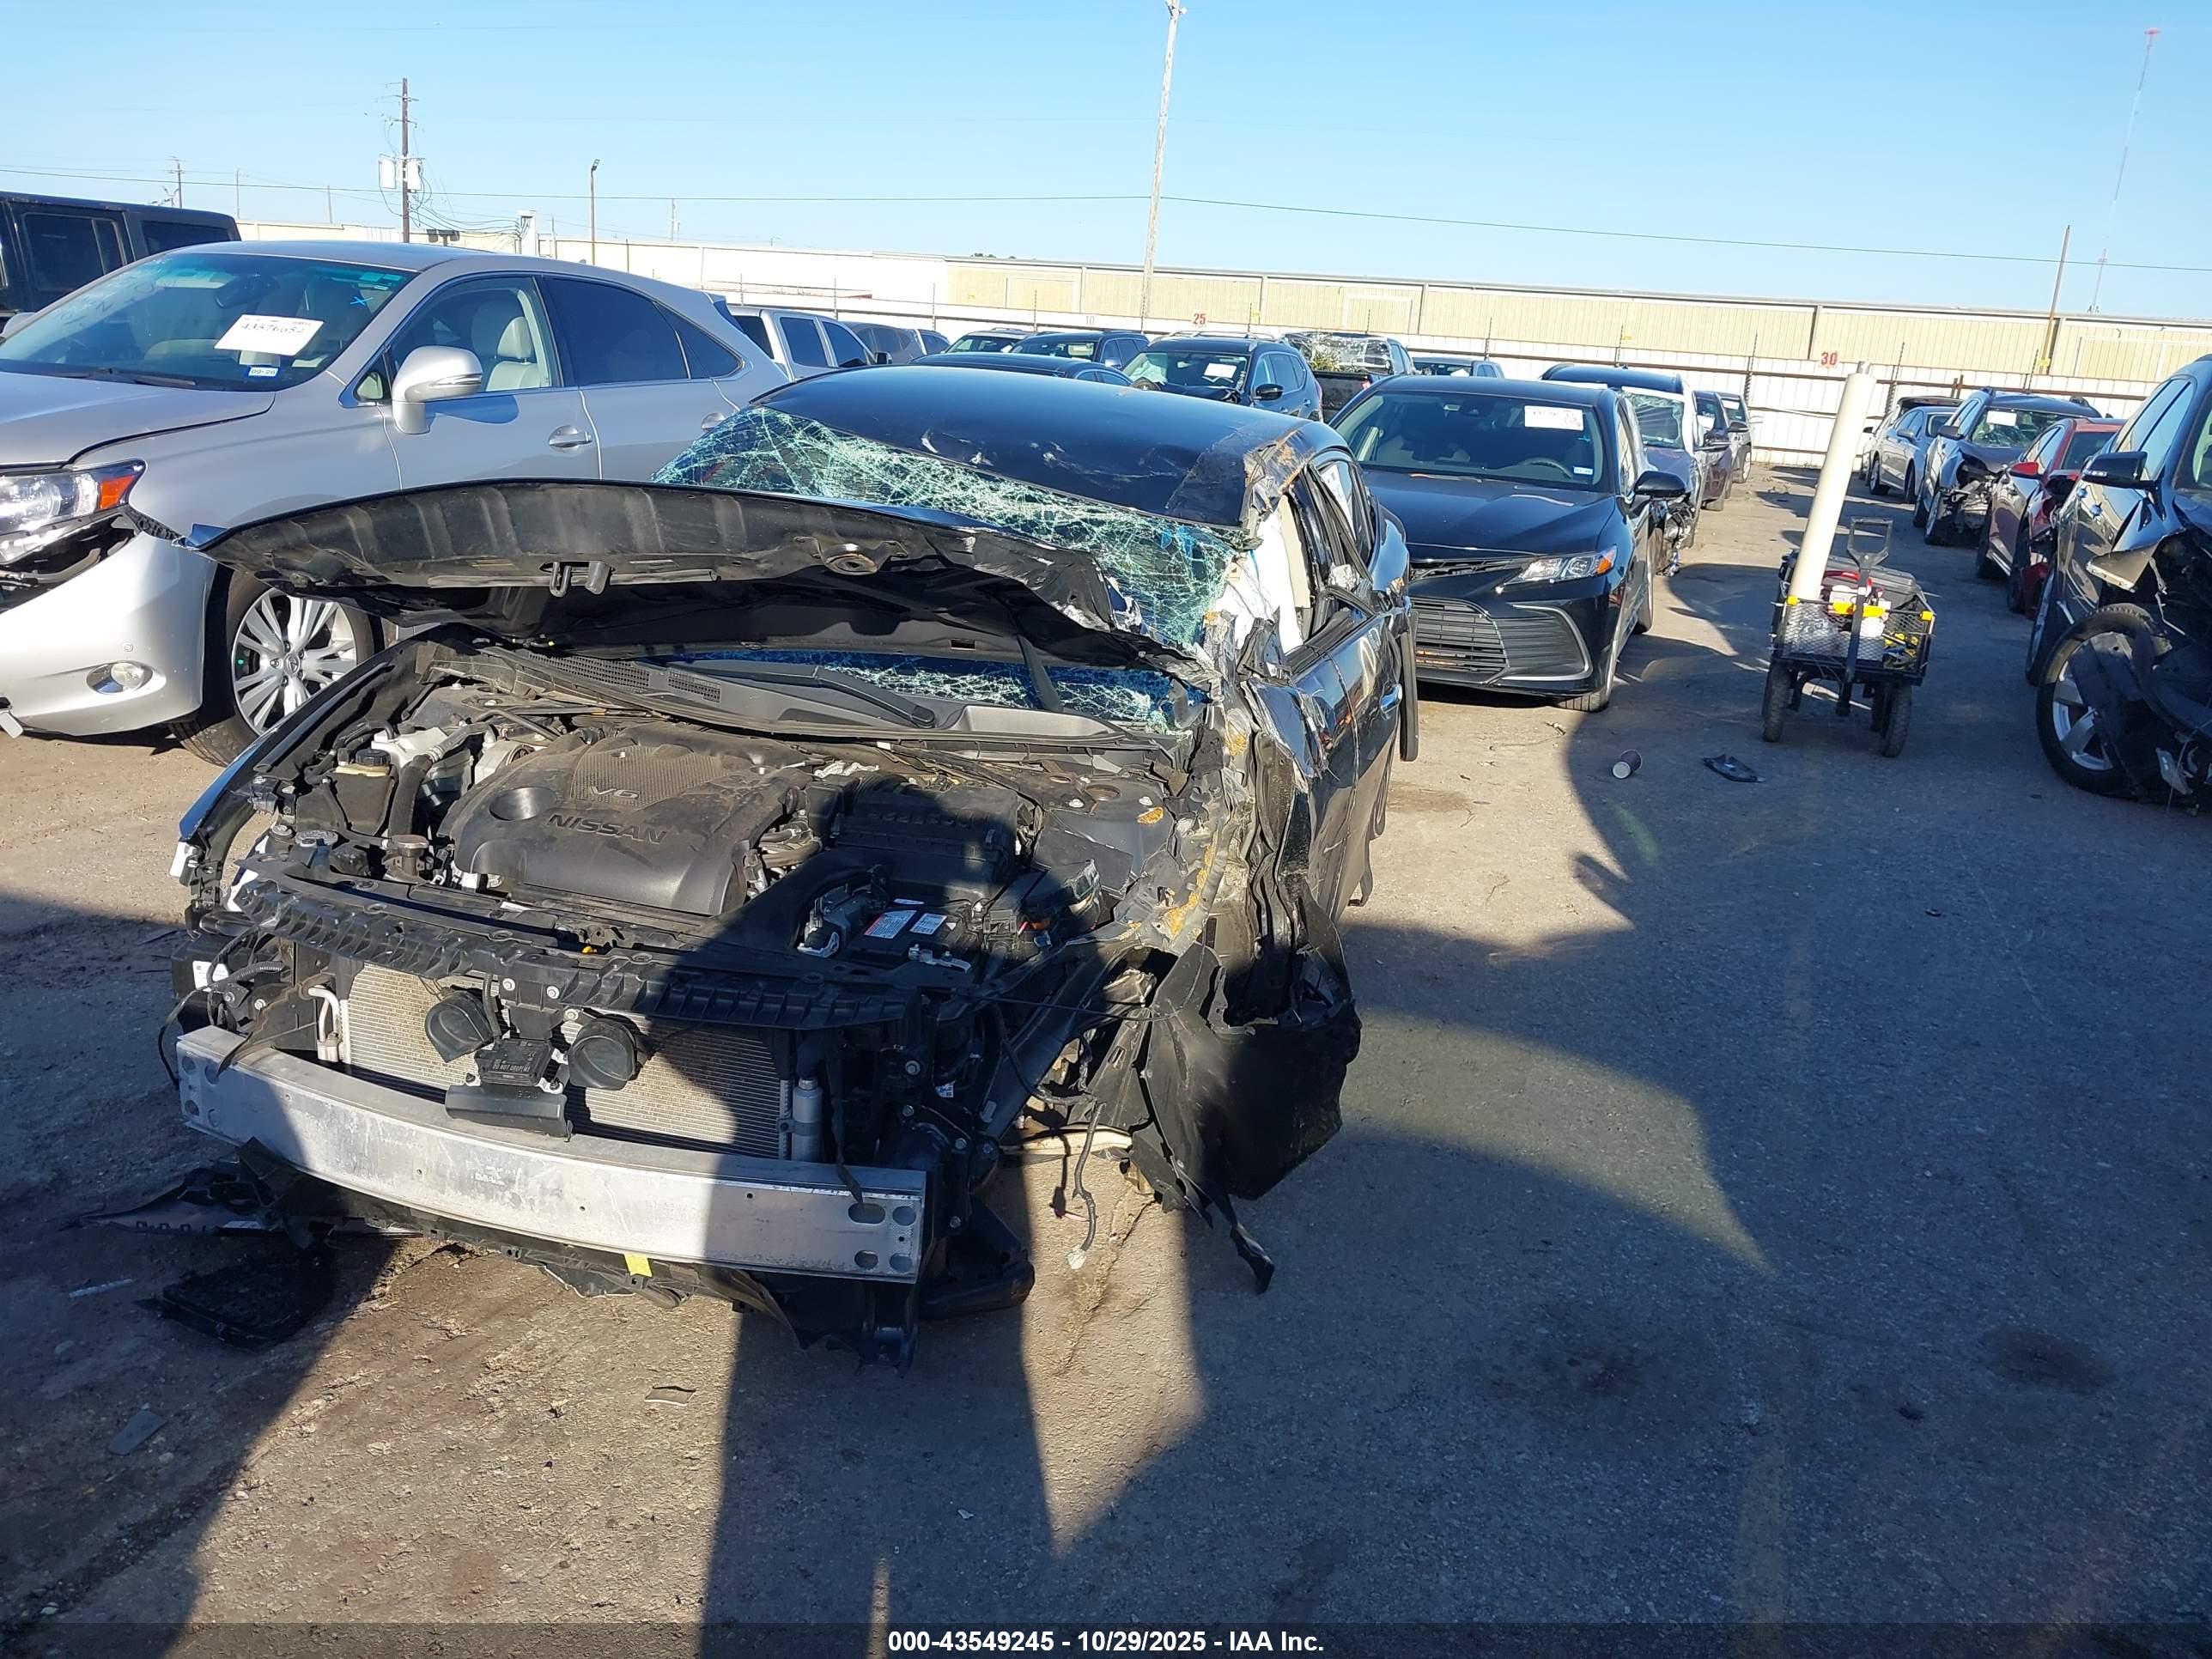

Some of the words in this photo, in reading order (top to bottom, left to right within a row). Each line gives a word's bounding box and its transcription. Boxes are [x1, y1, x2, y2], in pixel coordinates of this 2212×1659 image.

[1193, 313, 1206, 325] 25
[1820, 351, 1838, 366] 30
[589, 786, 641, 799] V6
[545, 814, 667, 844] NISSAN
